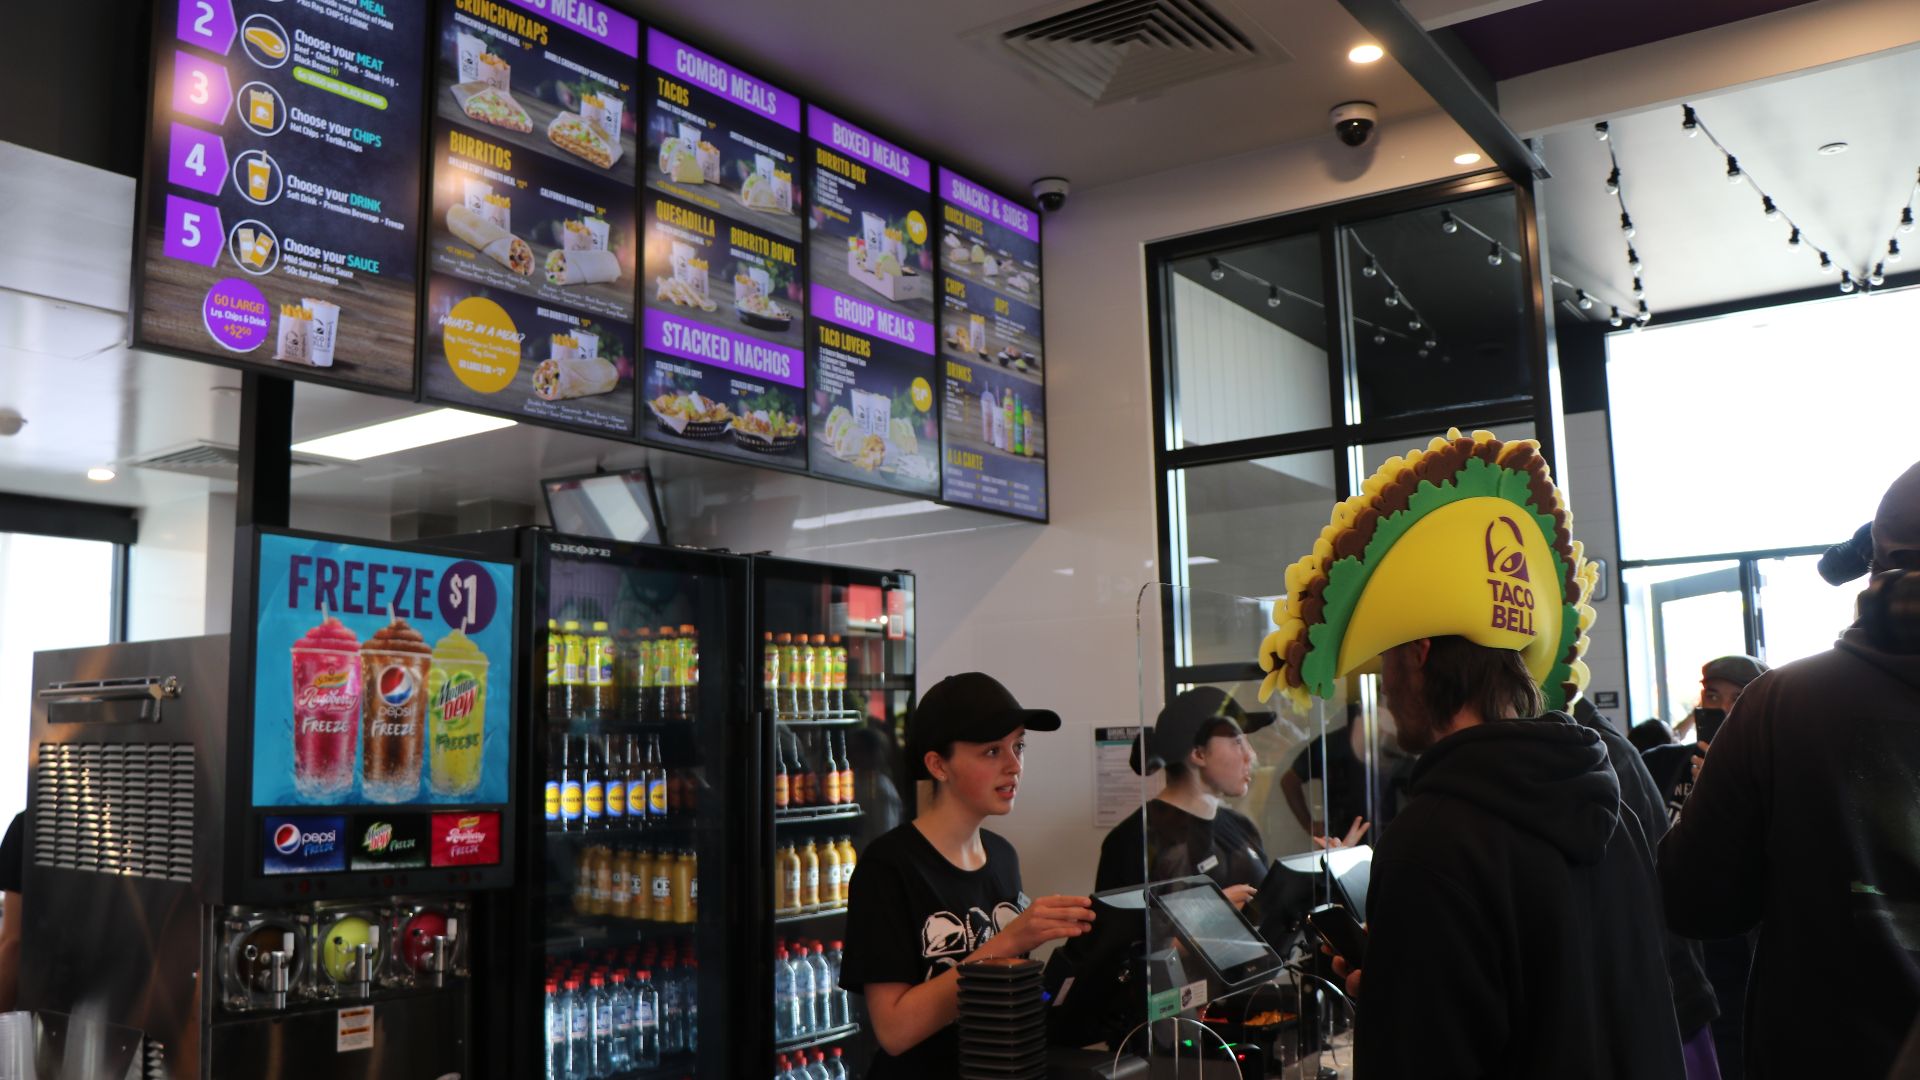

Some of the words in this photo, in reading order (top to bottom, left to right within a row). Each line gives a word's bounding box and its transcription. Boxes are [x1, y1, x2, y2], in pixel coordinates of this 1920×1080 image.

[195, 1, 215, 37] 2
[325, 8, 344, 22] CHIPS
[350, 16, 368, 31] DRINK
[455, 0, 549, 46] CRUNCHWRAPS
[551, 0, 608, 38] MEALS
[295, 29, 331, 52] Choose
[332, 45, 356, 62] your
[356, 52, 384, 72] MEAT
[315, 52, 338, 66] Chicken
[344, 61, 359, 74] Pork
[189, 71, 210, 105] 3
[657, 77, 690, 108] TACOS
[677, 48, 728, 92] COMBO
[731, 74, 776, 116] MEALS
[290, 122, 302, 133] Hot
[302, 126, 319, 138] Chips
[346, 142, 363, 152] Chips
[291, 107, 327, 130] Choose
[328, 122, 352, 137] your
[352, 128, 382, 148] CHIPS
[185, 144, 207, 177] 4
[450, 130, 512, 172] BURRITOS
[833, 122, 870, 158] BOXED
[872, 141, 910, 178] MEALS
[504, 174, 516, 187] MEAL
[816, 147, 850, 178] BURRITO
[850, 164, 866, 185] BOX
[286, 190, 300, 200] Soft
[300, 194, 318, 206] Drink
[324, 200, 351, 214] Premium
[287, 175, 324, 196] Choose
[325, 188, 348, 203] your
[350, 192, 382, 212] DRINK
[584, 202, 596, 214] MEAL
[952, 178, 990, 214] SNACKS
[992, 198, 1000, 220] &
[1002, 204, 1028, 233] SIDES
[181, 212, 202, 248] 5
[656, 200, 716, 238] QUESADILLA
[964, 214, 984, 236] BITES
[284, 238, 321, 258] Choose
[322, 250, 346, 265] your
[346, 254, 380, 274] SAUCE
[731, 226, 770, 256] BURRITO
[771, 241, 797, 266] BOWL
[283, 254, 299, 264] Mild
[299, 257, 317, 270] Sauce
[323, 263, 336, 274] Fire
[336, 266, 354, 278] Sauce
[210, 307, 224, 320] Lrg.
[224, 310, 243, 322] Chips
[250, 315, 267, 327] Drink
[214, 293, 229, 306] GO
[230, 297, 264, 316] LARGE!
[834, 295, 874, 328] GROUP
[877, 310, 916, 343] MEALS
[439, 314, 474, 332] WHAT'S
[474, 324, 487, 334] IN
[487, 326, 495, 336] A
[496, 329, 526, 344] MEAL?
[819, 325, 840, 349] TACO
[841, 332, 871, 358] LOVERS
[662, 320, 730, 362] STACKED
[734, 340, 790, 378] NACHOS
[946, 360, 972, 383] DRINKS
[953, 450, 962, 466] LA
[962, 452, 984, 471] CARTE
[550, 543, 611, 558] SKOPE
[289, 554, 434, 620] FREEZE
[449, 573, 478, 625] $1
[1487, 579, 1534, 610] TACO
[1492, 604, 1538, 636] BELL
[299, 686, 358, 710] Raspberry
[378, 706, 416, 719] pepsi
[302, 718, 349, 737] FREEZE
[371, 720, 416, 738] FREEZE
[435, 732, 480, 753] FREEZE
[302, 830, 336, 845] pepsi
[304, 842, 334, 857] FREEZE
[390, 839, 416, 852] FREEZE
[446, 828, 486, 844] Raspberry
[451, 845, 479, 858] FREEZE
[652, 878, 670, 890] ICE
